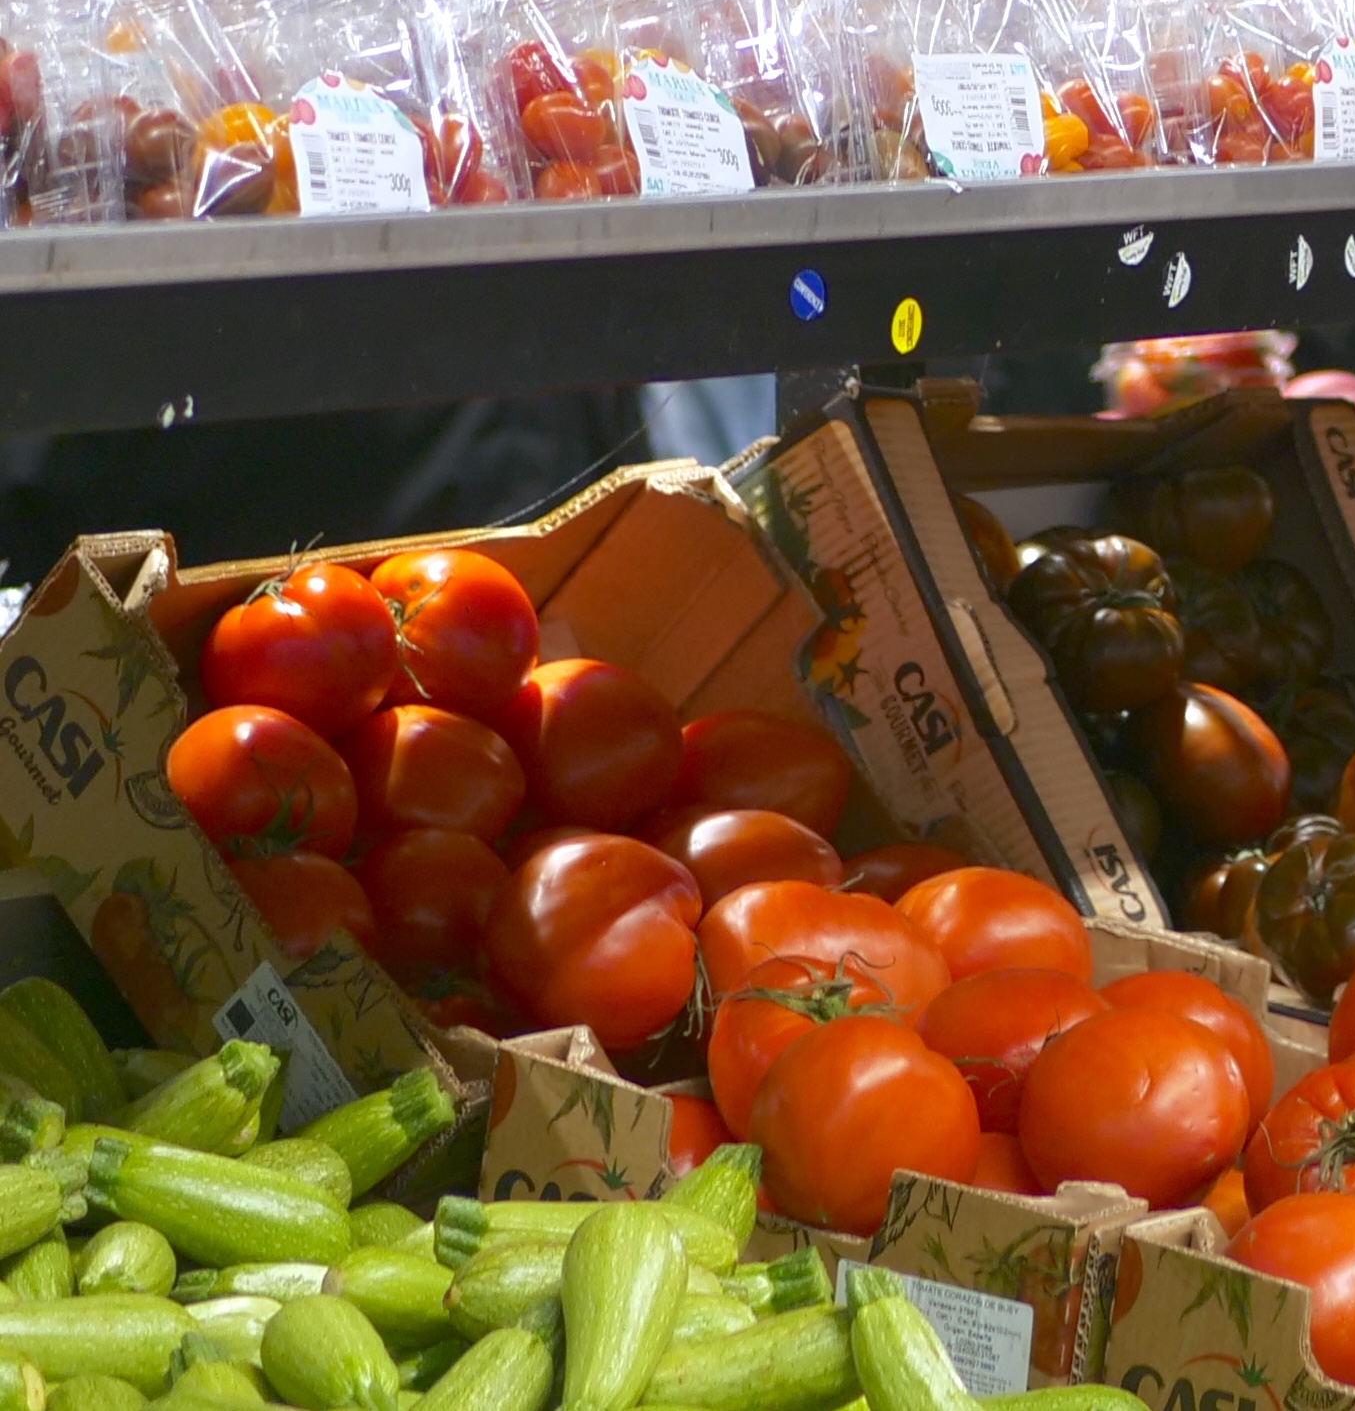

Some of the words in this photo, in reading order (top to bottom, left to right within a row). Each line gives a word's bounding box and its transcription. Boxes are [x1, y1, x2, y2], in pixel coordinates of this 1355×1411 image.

[389, 172, 411, 197] 300g
[4, 655, 106, 800] CASI
[880, 695, 929, 775] GOURMET
[895, 661, 956, 757] CASI
[0, 716, 63, 806] Gourmet
[1092, 842, 1147, 923] CASI
[266, 988, 296, 1028] CASI
